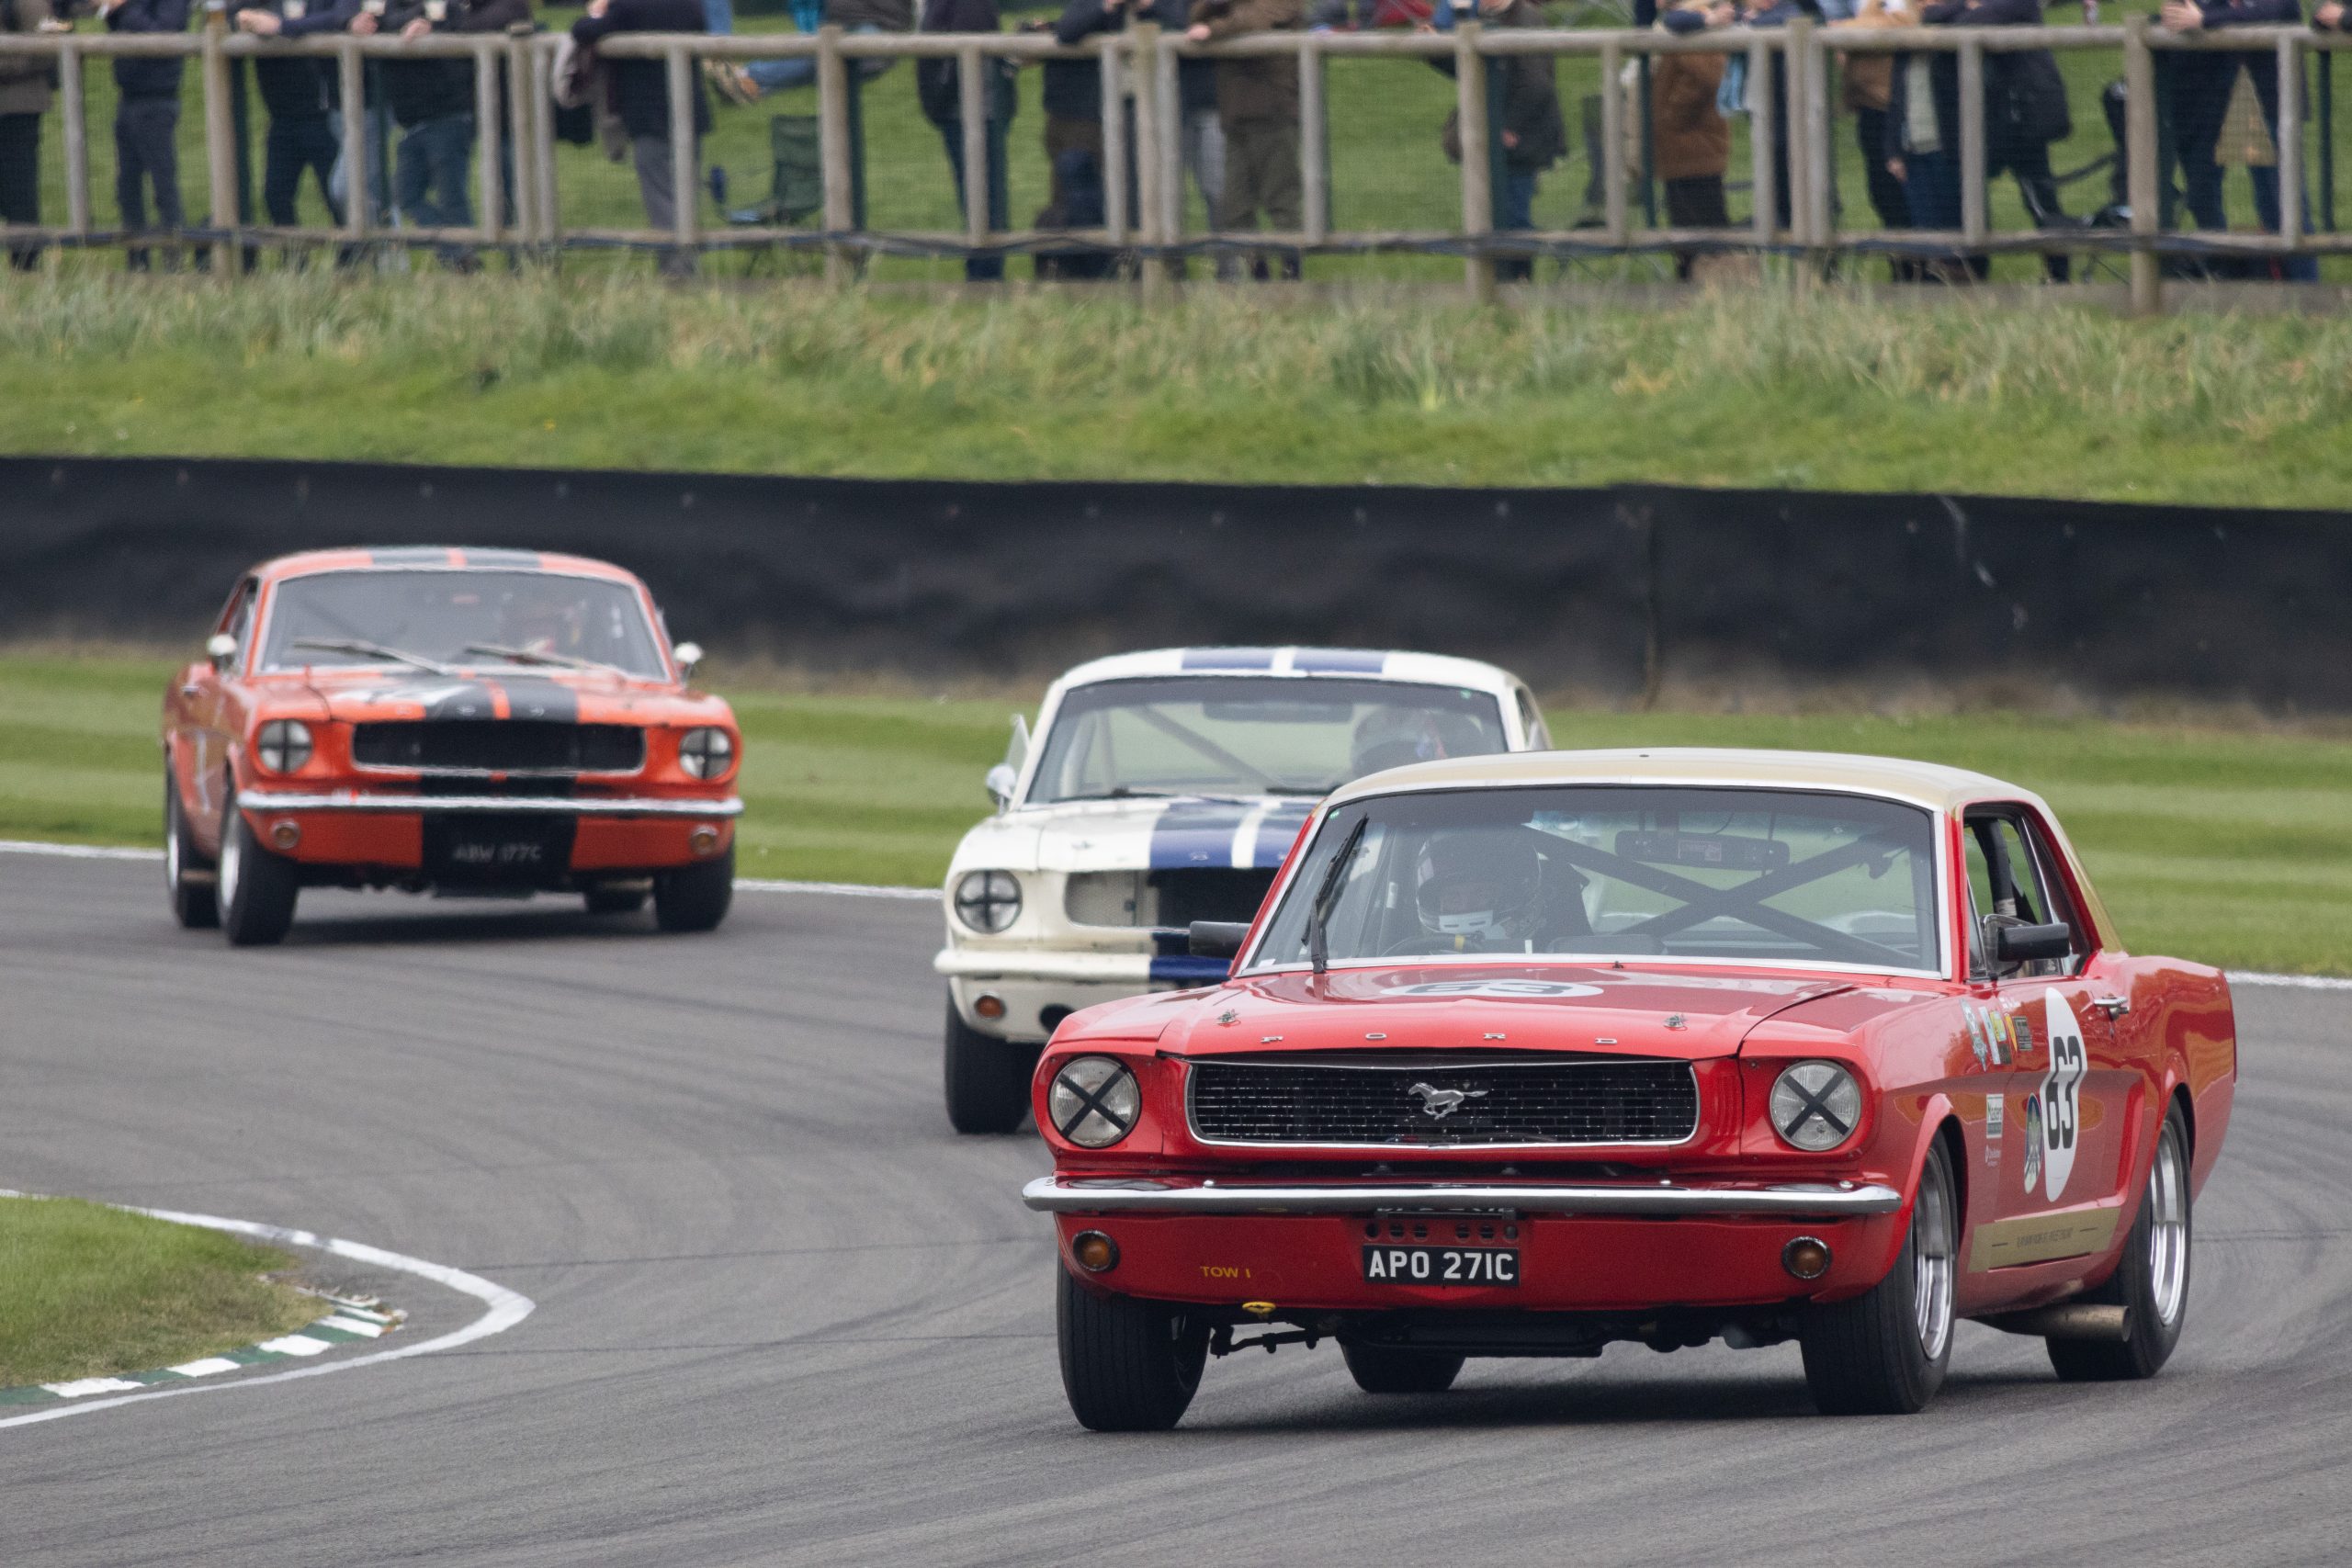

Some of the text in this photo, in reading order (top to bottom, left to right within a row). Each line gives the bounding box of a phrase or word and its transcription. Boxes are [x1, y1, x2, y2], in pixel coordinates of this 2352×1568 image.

[2045, 1035, 2083, 1150] 63
[1200, 1266, 1239, 1279] TOW
[1368, 1250, 1514, 1280] APO 271C
